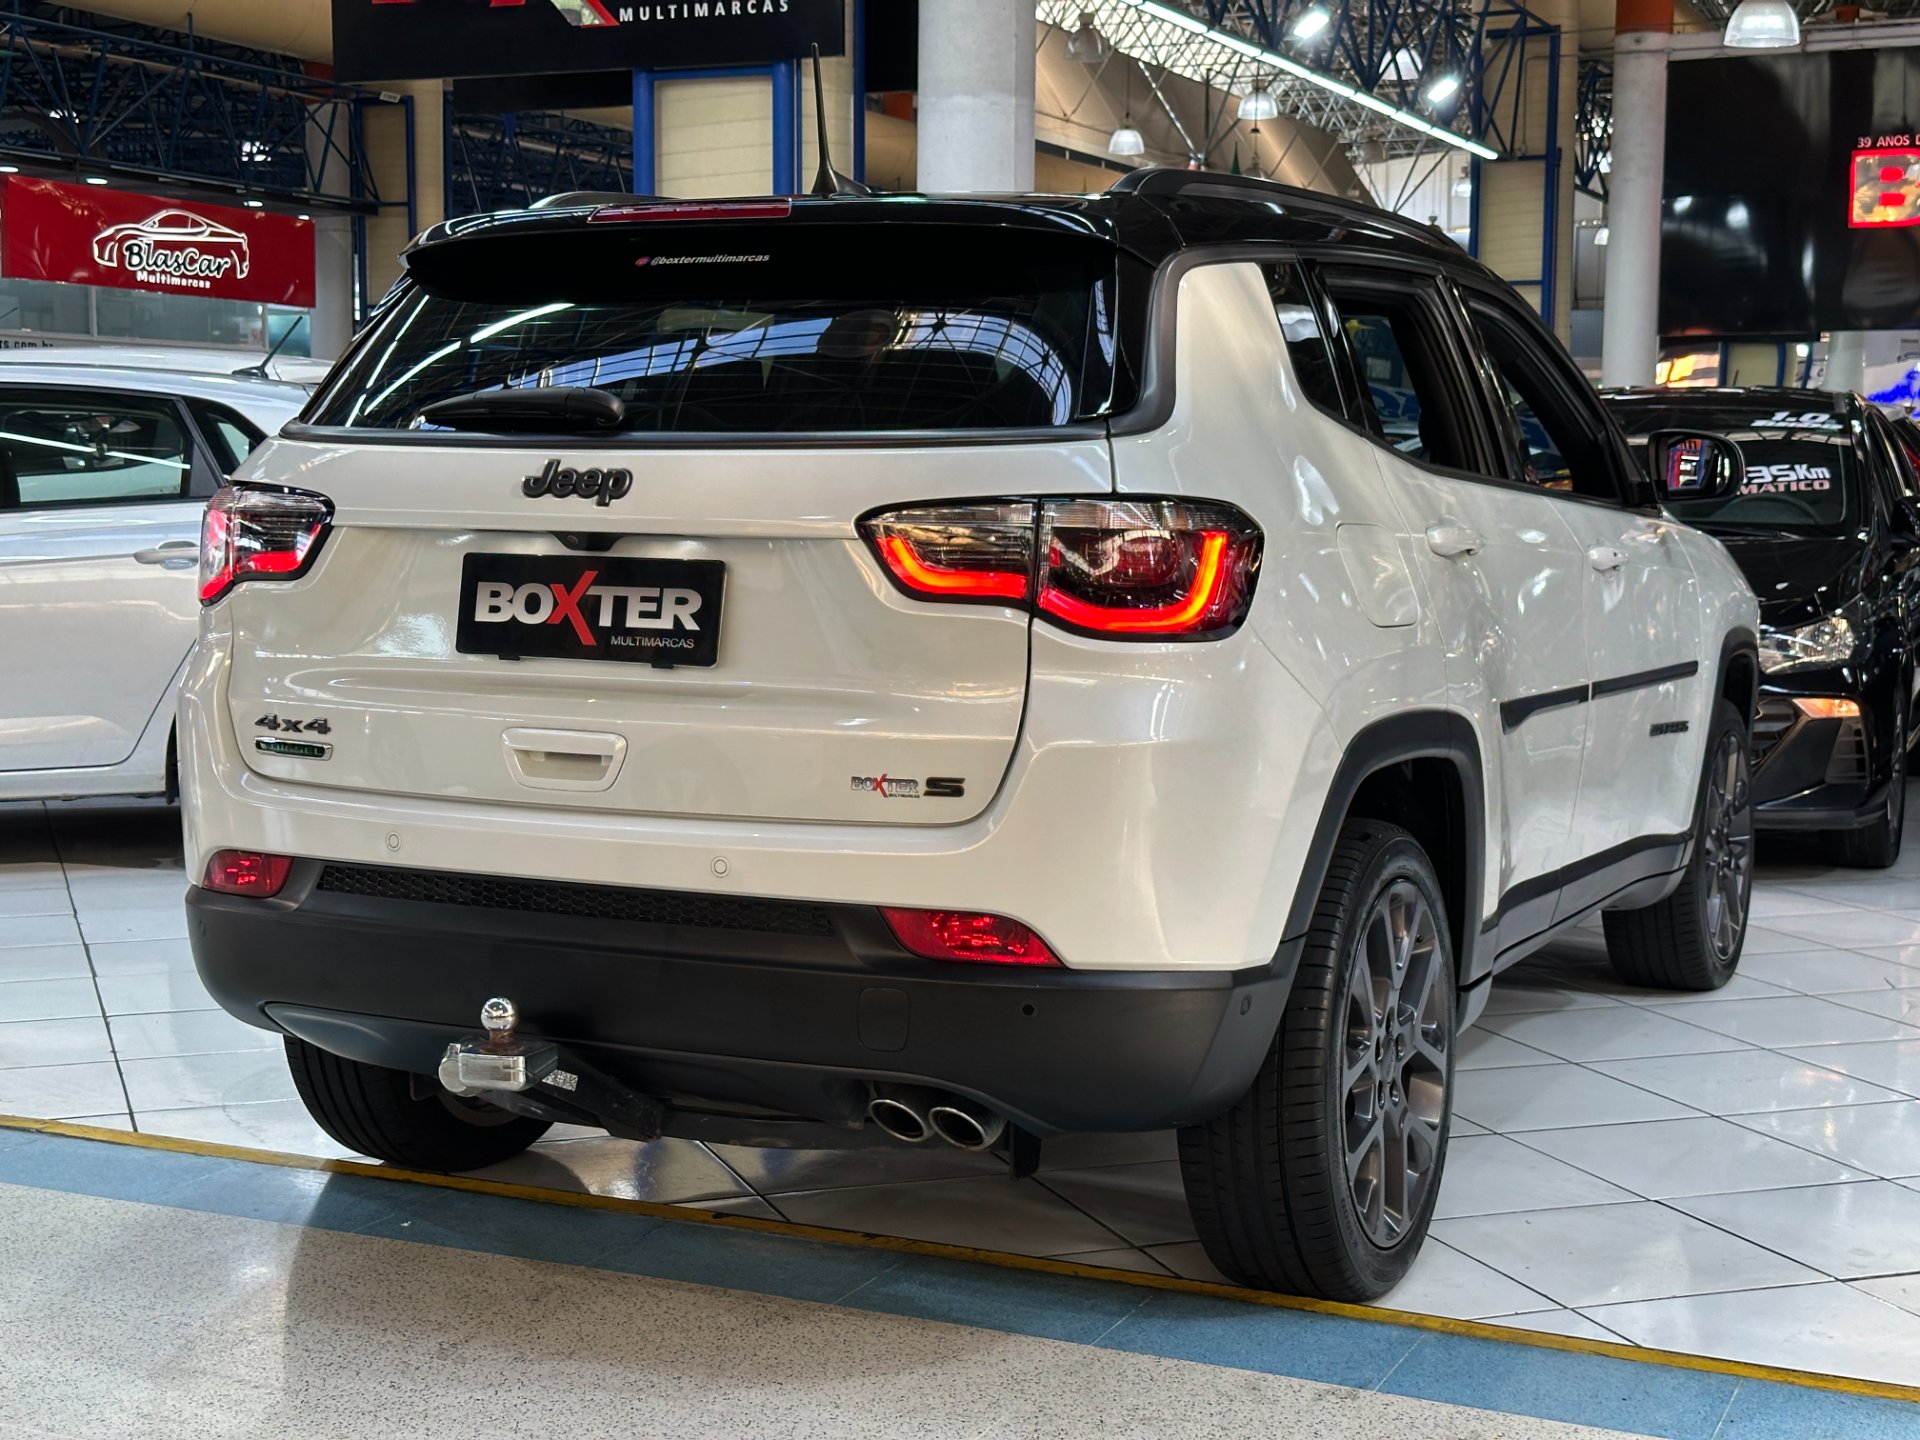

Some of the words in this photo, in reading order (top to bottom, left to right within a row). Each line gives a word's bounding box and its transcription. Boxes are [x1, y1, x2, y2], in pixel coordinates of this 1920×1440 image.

[619, 0, 789, 22] MULTIMARCAS
[1857, 137, 1872, 148] 39
[1876, 134, 1910, 147] ANOS
[124, 239, 231, 279] BlasCar
[650, 254, 770, 266] @boxtermultimarcas
[136, 270, 211, 289] Multimarcas
[522, 458, 633, 507] Jeep
[1743, 464, 1831, 484] 35Km
[474, 570, 703, 646] BOXTER
[610, 635, 695, 649] MULTIMARCAS
[254, 713, 331, 735] 4x4
[850, 774, 919, 798] BOXTER
[923, 777, 966, 798] S
